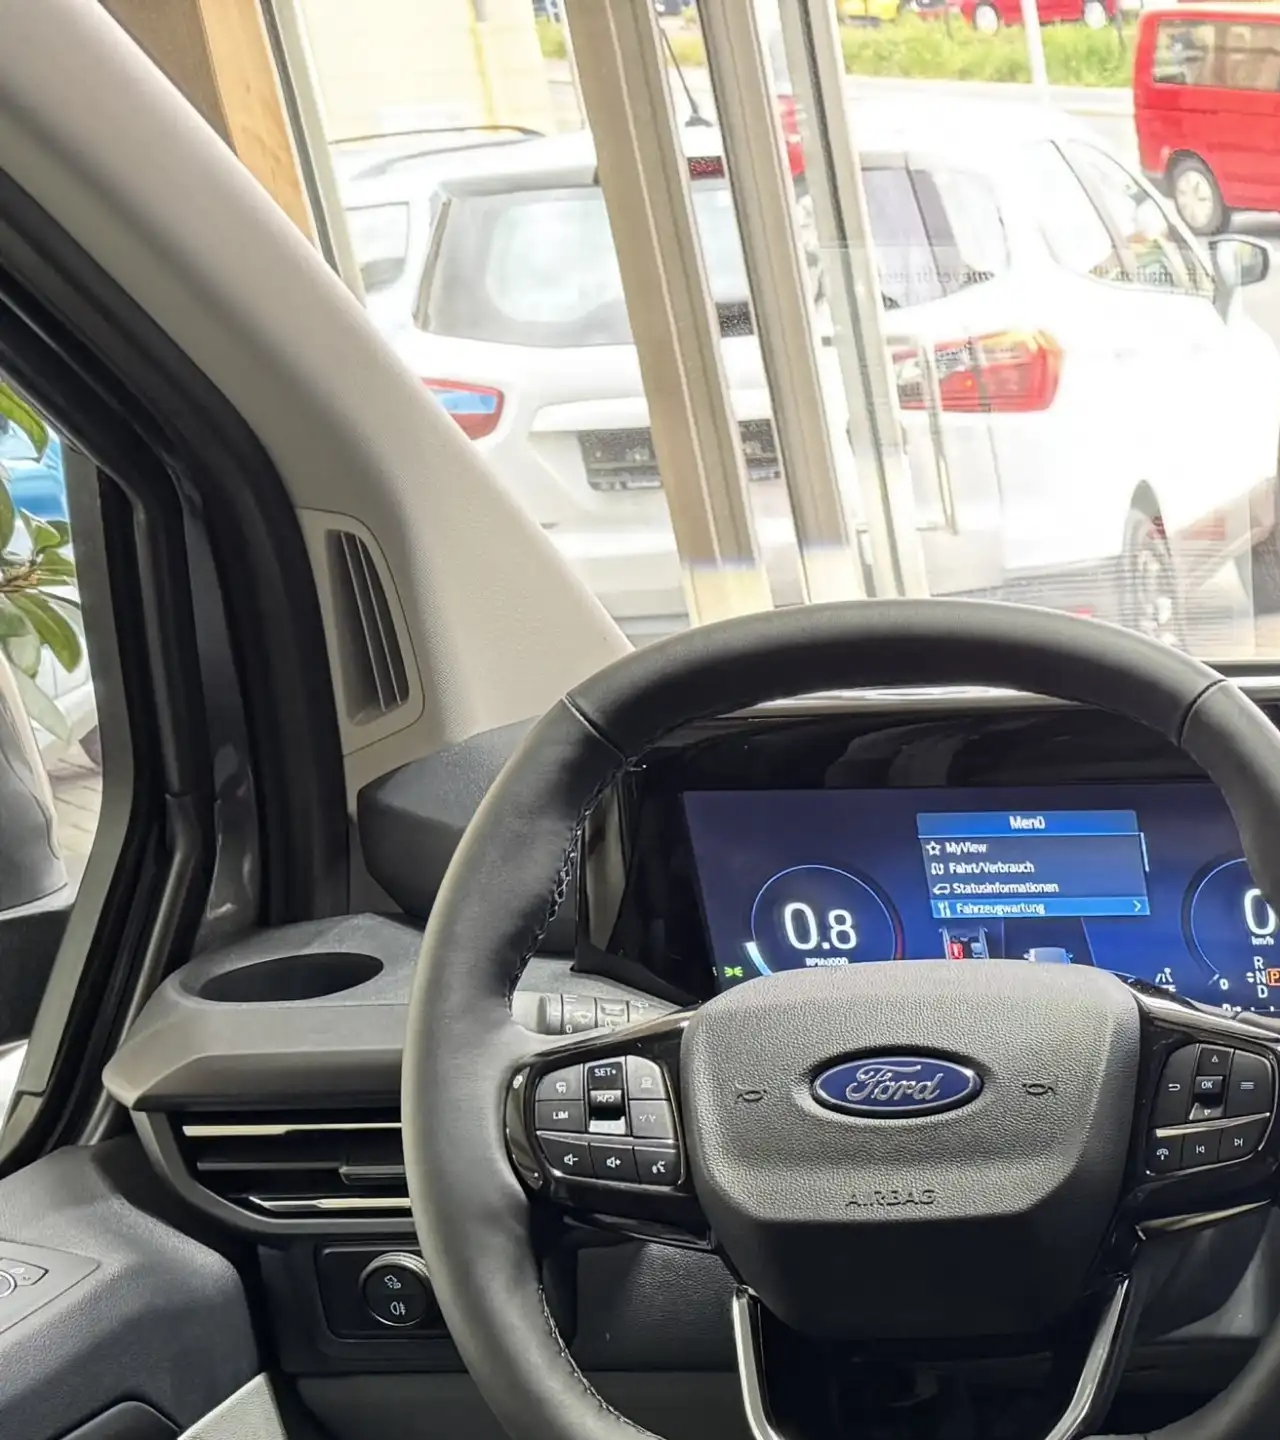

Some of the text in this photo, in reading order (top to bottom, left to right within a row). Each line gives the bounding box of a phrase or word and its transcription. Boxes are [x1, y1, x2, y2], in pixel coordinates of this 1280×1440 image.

[1008, 815, 1046, 830] Menü
[945, 841, 988, 856] MyView
[949, 860, 1035, 874] Fahrt/Verbrauch
[952, 882, 1059, 895] Statusinformationen
[956, 902, 1046, 916] Fahrzeugwartung
[783, 901, 858, 951] 0.8
[1250, 935, 1275, 946] km/h
[1253, 956, 1265, 970] R
[1255, 970, 1280, 984] N P
[1219, 978, 1229, 991] 0
[1257, 985, 1269, 999] D
[845, 1064, 945, 1101] Ford
[1201, 1080, 1214, 1089] OK
[552, 1110, 569, 1120] LIM
[845, 1189, 937, 1207] AIRBAG
